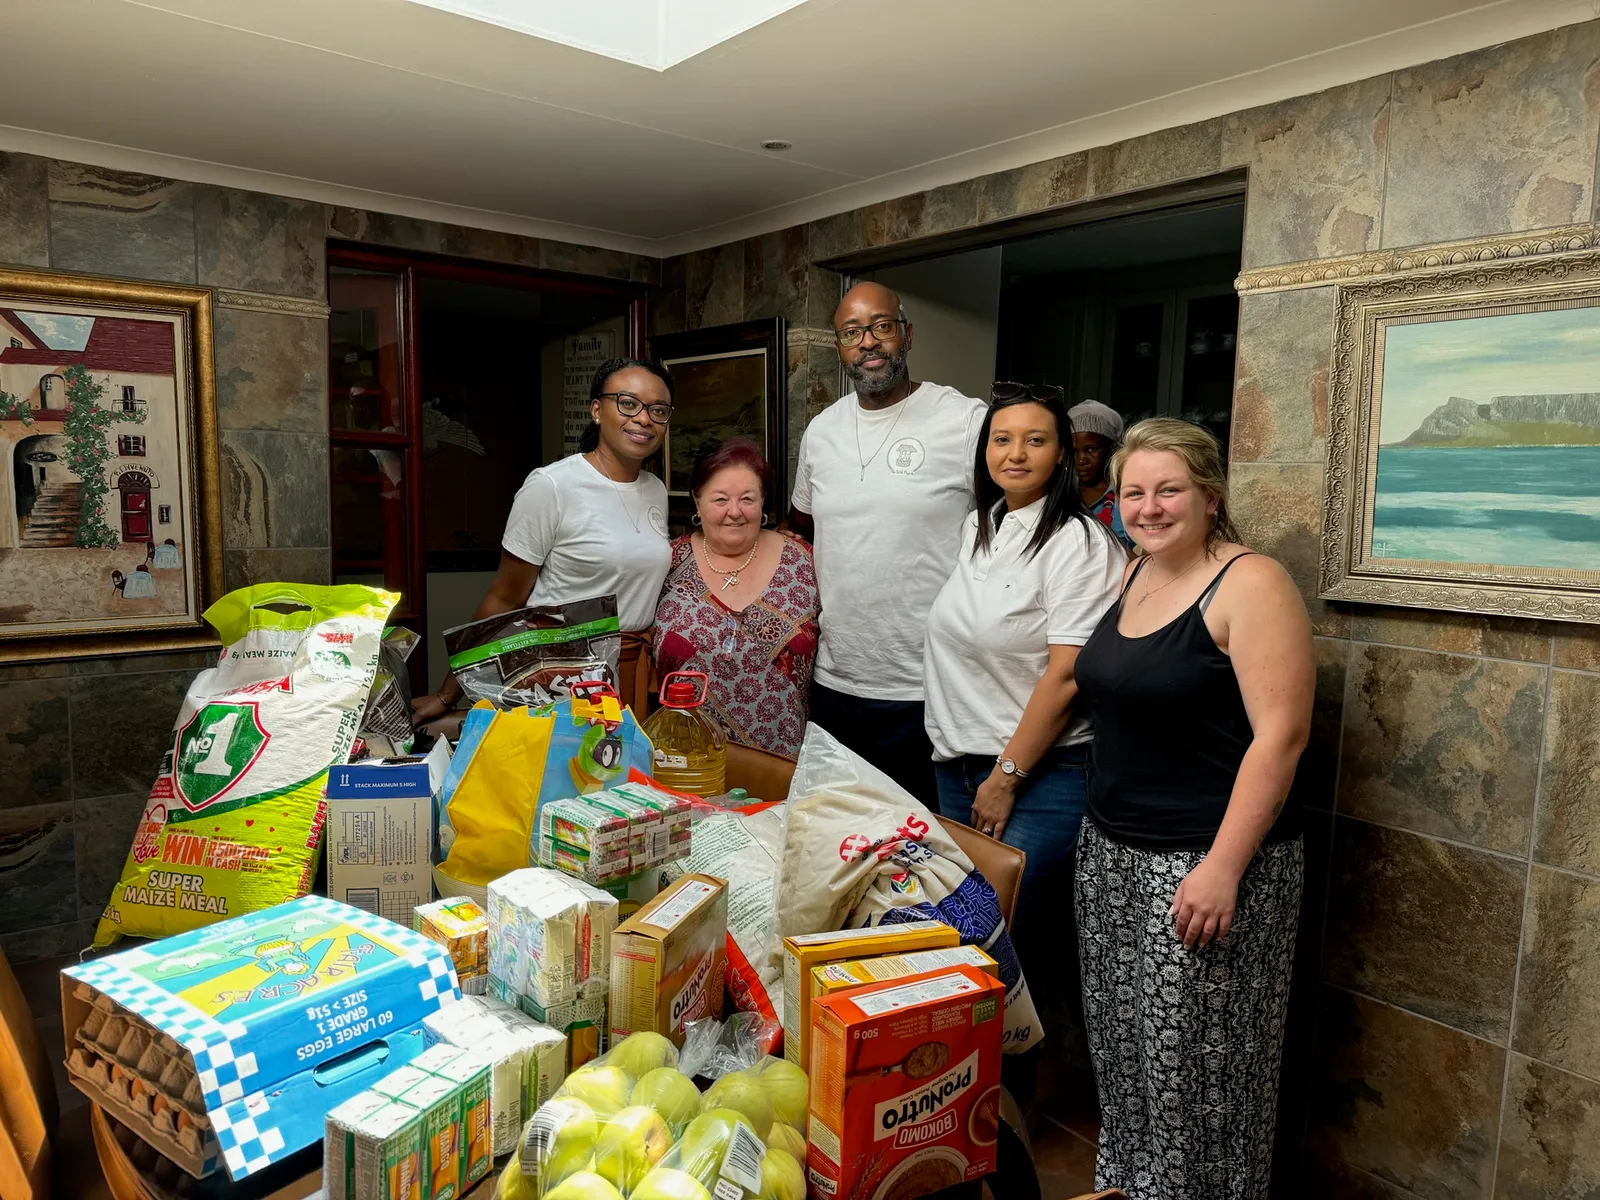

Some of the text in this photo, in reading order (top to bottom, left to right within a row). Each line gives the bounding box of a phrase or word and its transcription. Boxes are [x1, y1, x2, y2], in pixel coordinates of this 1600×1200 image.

[162, 834, 207, 866] WIN
[204, 856, 214, 868] IN
[215, 857, 242, 871] CASH
[148, 870, 203, 892] SUPER
[123, 885, 228, 914] MAIZE MEAL
[306, 1004, 331, 1021] 51g
[341, 989, 368, 1009] SIZE
[316, 1005, 368, 1035] GRADE 1
[853, 1027, 879, 1039] 500 g
[1012, 1025, 1031, 1042] kg
[296, 1010, 393, 1061] 60 LARGE EGGS
[882, 1065, 971, 1129] ProNutro
[476, 1102, 485, 1143] MANGO
[899, 1114, 952, 1145] BOKOMO
[440, 1129, 450, 1171] MANGO
[400, 1160, 411, 1200] MANGO
